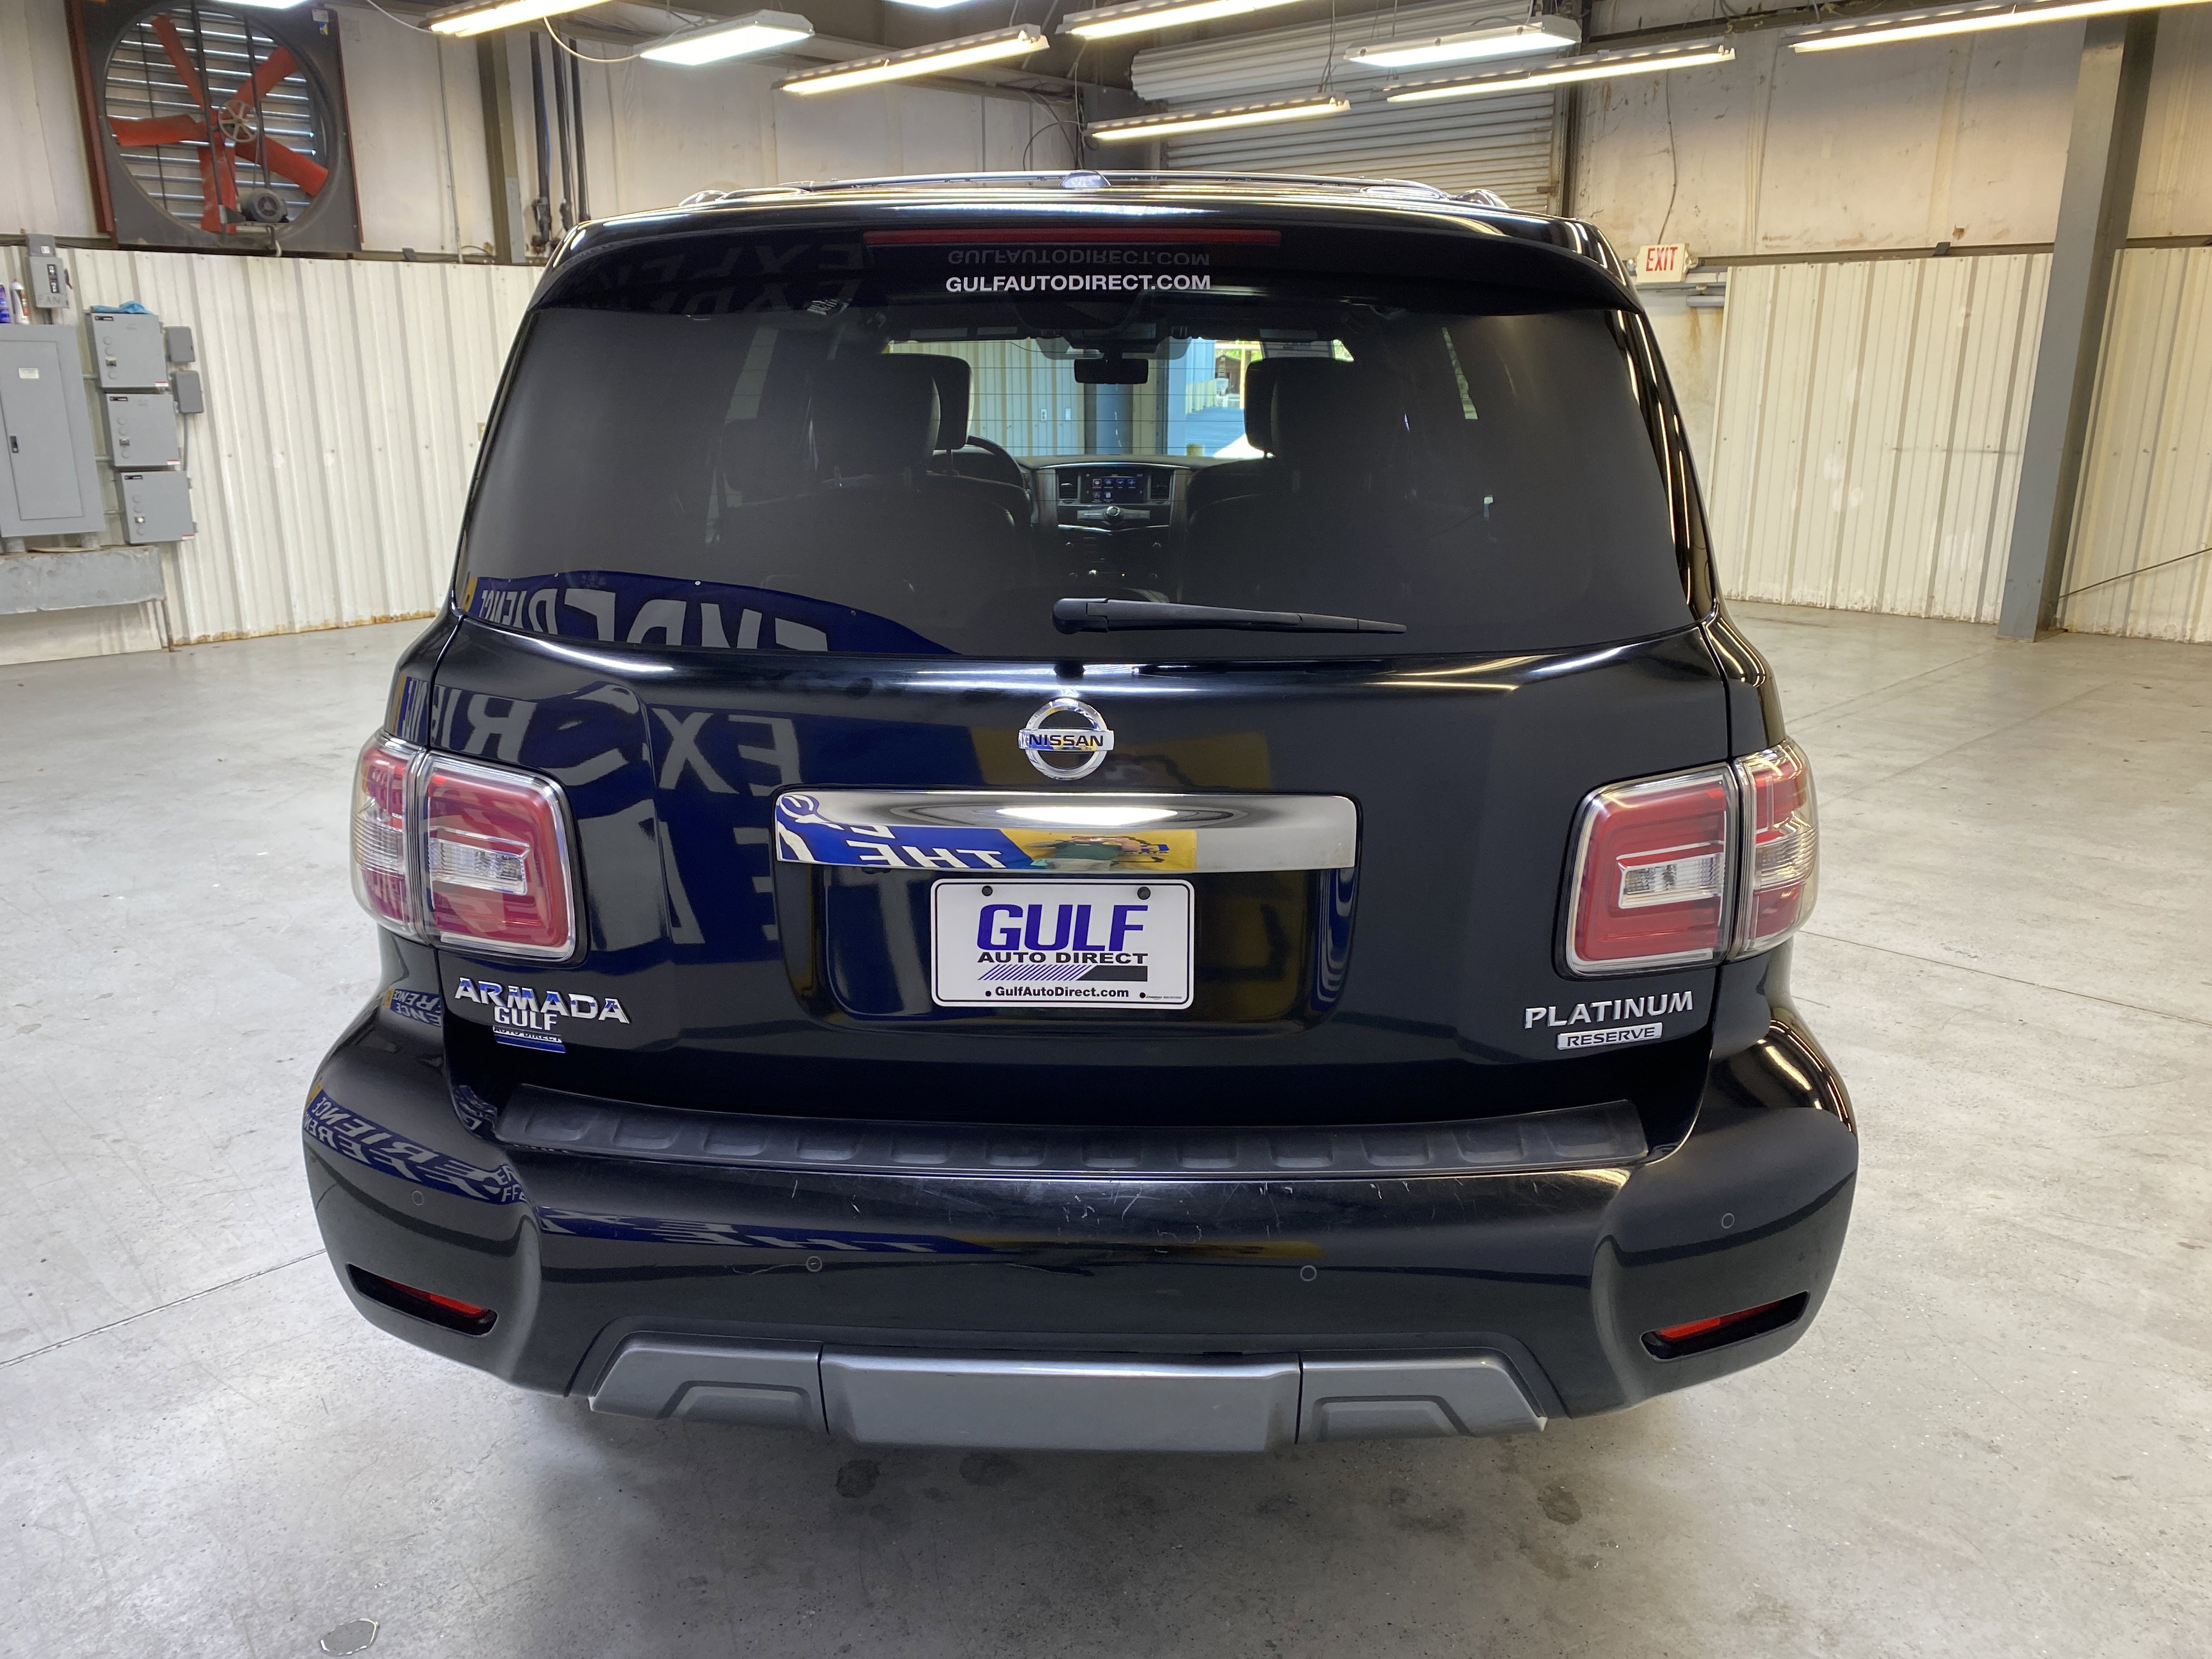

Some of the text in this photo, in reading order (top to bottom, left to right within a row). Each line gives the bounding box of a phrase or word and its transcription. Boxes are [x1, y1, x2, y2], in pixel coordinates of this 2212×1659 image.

[1646, 247, 1678, 272] EXIT
[946, 274, 1211, 292] GULFAUTODIRECT.COM
[1029, 734, 1103, 747] NISSAN
[977, 904, 1148, 952] GULF
[977, 952, 1148, 964] AUTO DIRECT
[454, 977, 631, 1024] ARMADA
[995, 986, 1129, 998] GulfAutoDirect.com
[494, 1006, 557, 1031] GULF
[1524, 991, 1694, 1029] PLATINUM
[1567, 1027, 1655, 1047] RESERVE
